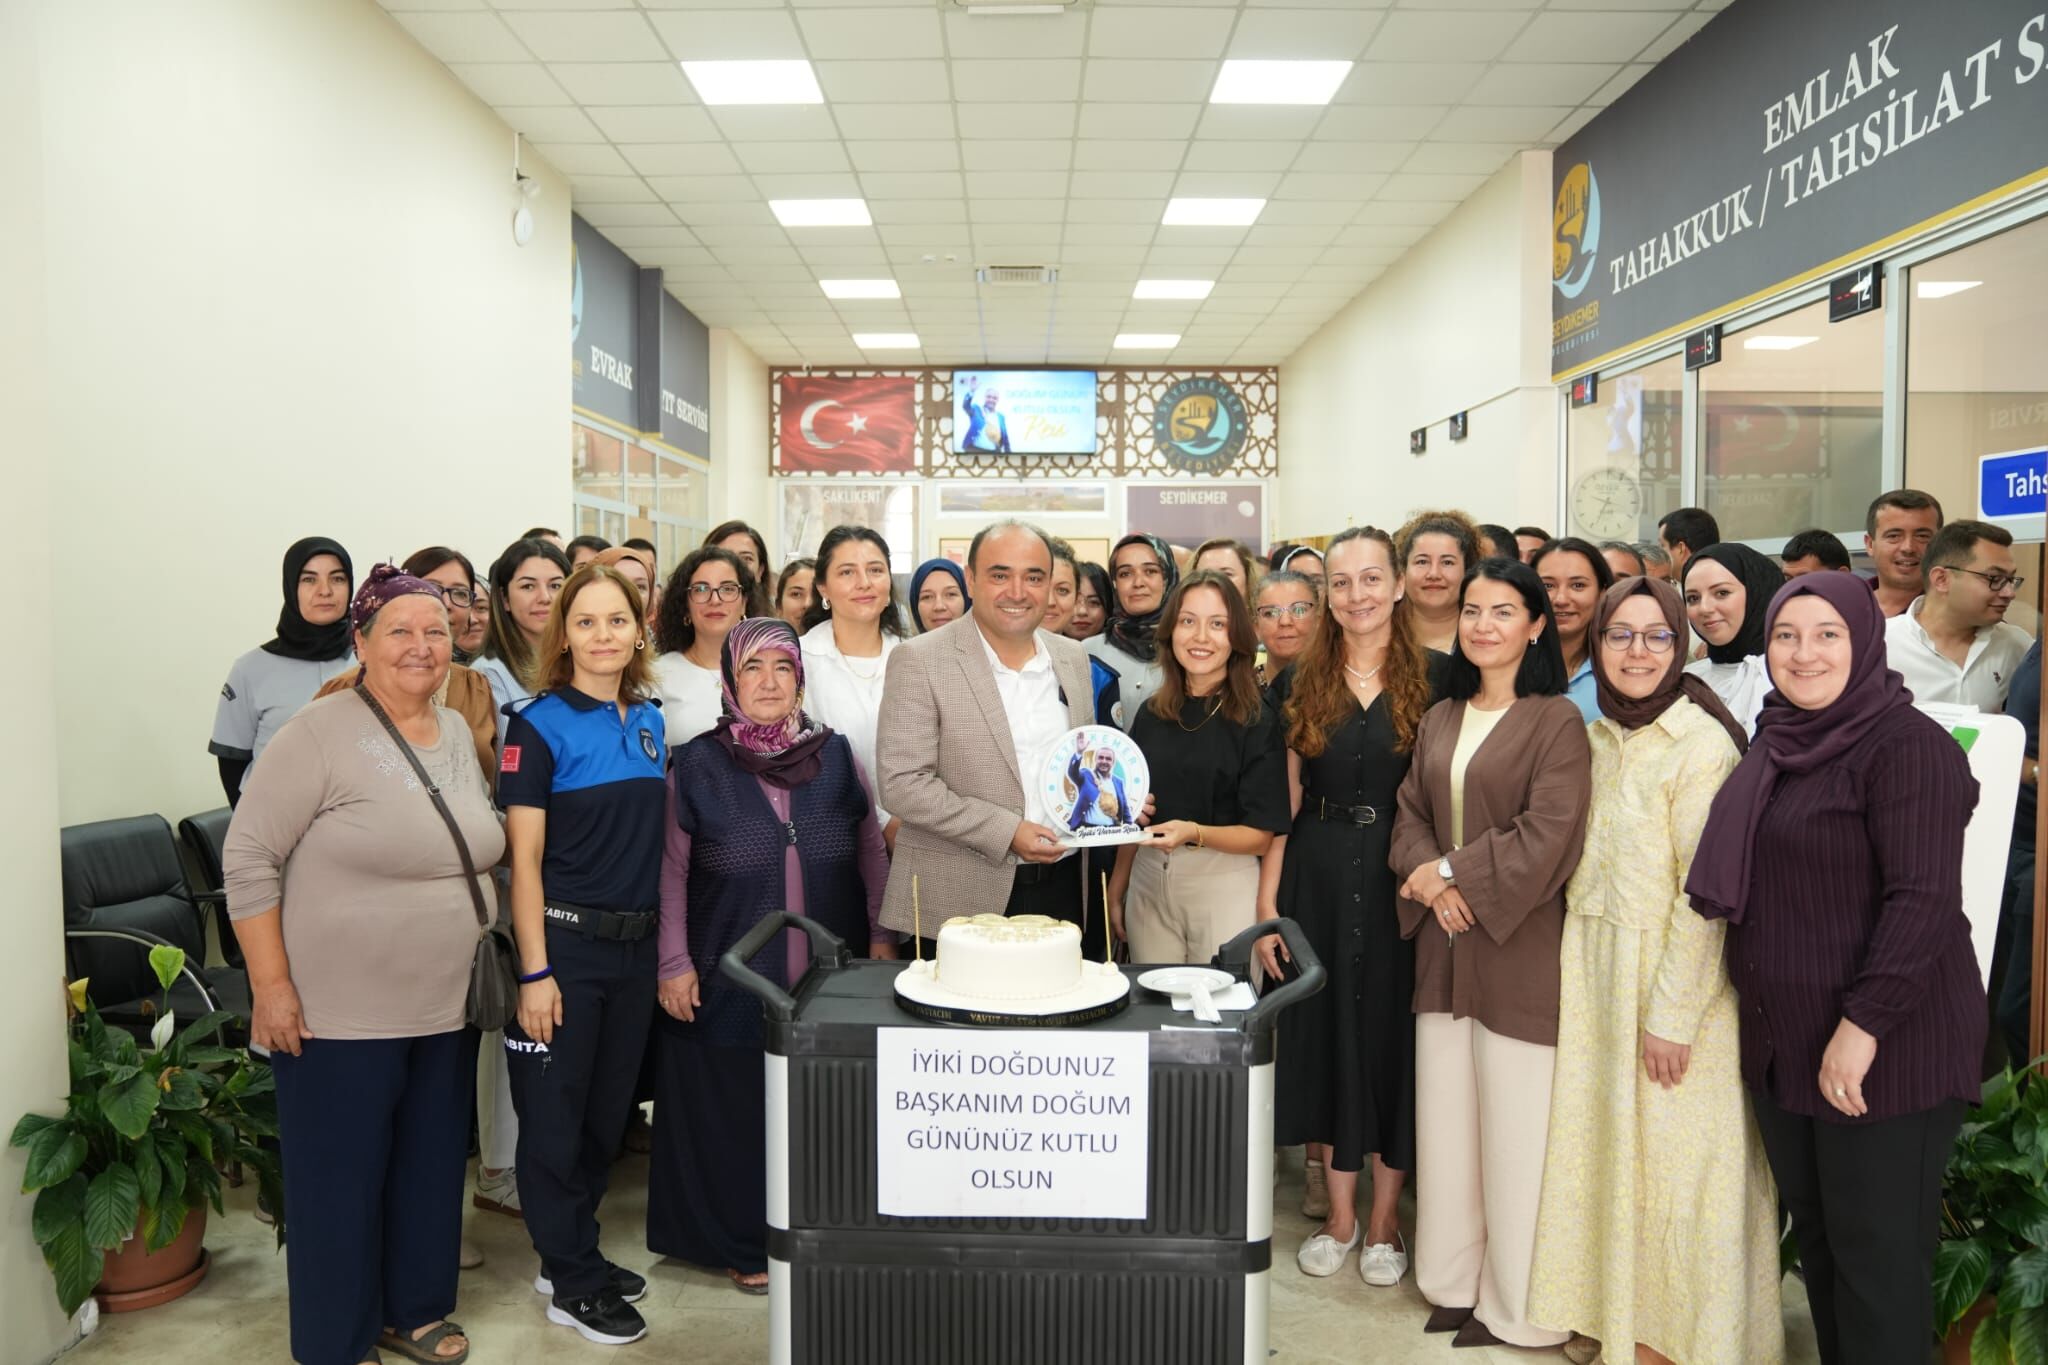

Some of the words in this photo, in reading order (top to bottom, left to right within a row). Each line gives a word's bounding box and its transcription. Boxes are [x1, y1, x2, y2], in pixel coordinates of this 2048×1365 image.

[1762, 23, 1900, 154] EMLAK
[1609, 183, 1754, 295] TAHAKKUK
[1780, 38, 2002, 209] TAHSİLAT
[2014, 12, 2048, 85] S
[1706, 334, 1713, 355] 3
[590, 344, 633, 391] EVRAK
[676, 397, 708, 433] SERVİSİ
[1159, 488, 1228, 505] SEYDİKEMER
[912, 1048, 962, 1074] İYİKİ
[970, 1050, 1116, 1077] DOĞDUNUZ
[895, 1091, 1023, 1116] BAŞKANIM
[1032, 1090, 1131, 1115] DOĞUM
[906, 1125, 1033, 1152] GÜNÜNÜZ
[1041, 1132, 1118, 1153] KUTLU
[970, 1169, 1053, 1190] OLSUN
